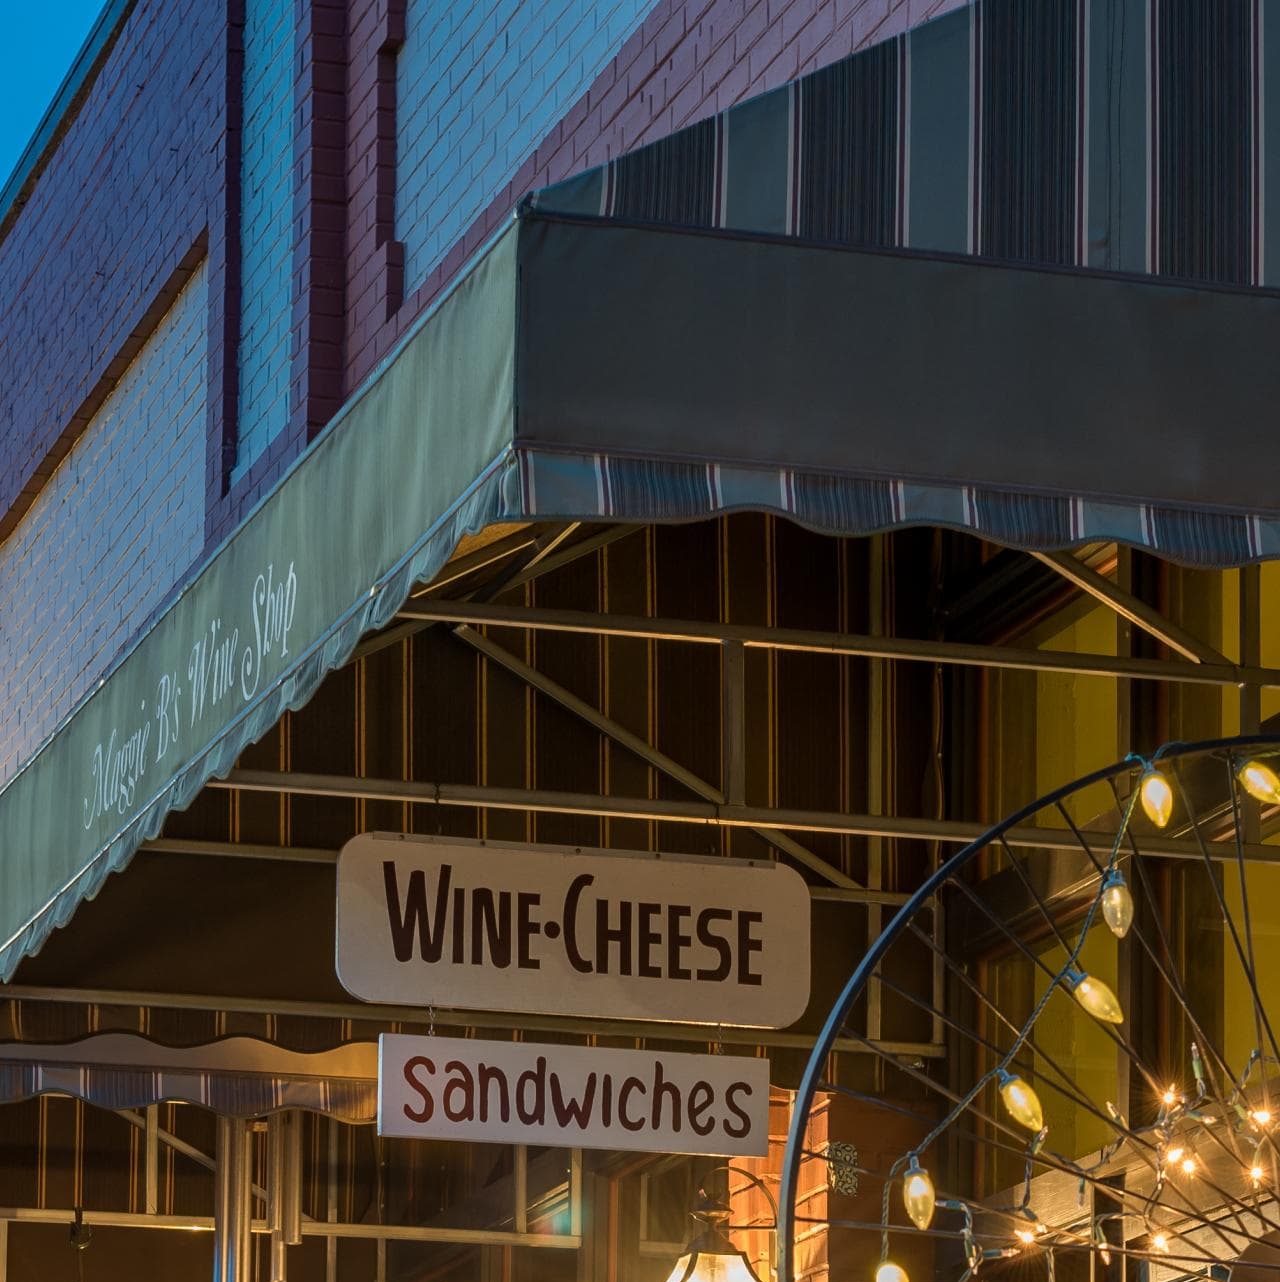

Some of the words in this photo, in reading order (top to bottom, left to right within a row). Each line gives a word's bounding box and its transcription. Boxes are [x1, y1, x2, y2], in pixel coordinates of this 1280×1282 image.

[83, 700, 150, 830] Maggie
[156, 672, 182, 764] B's
[188, 618, 239, 728] Wine
[241, 561, 297, 700] Shop
